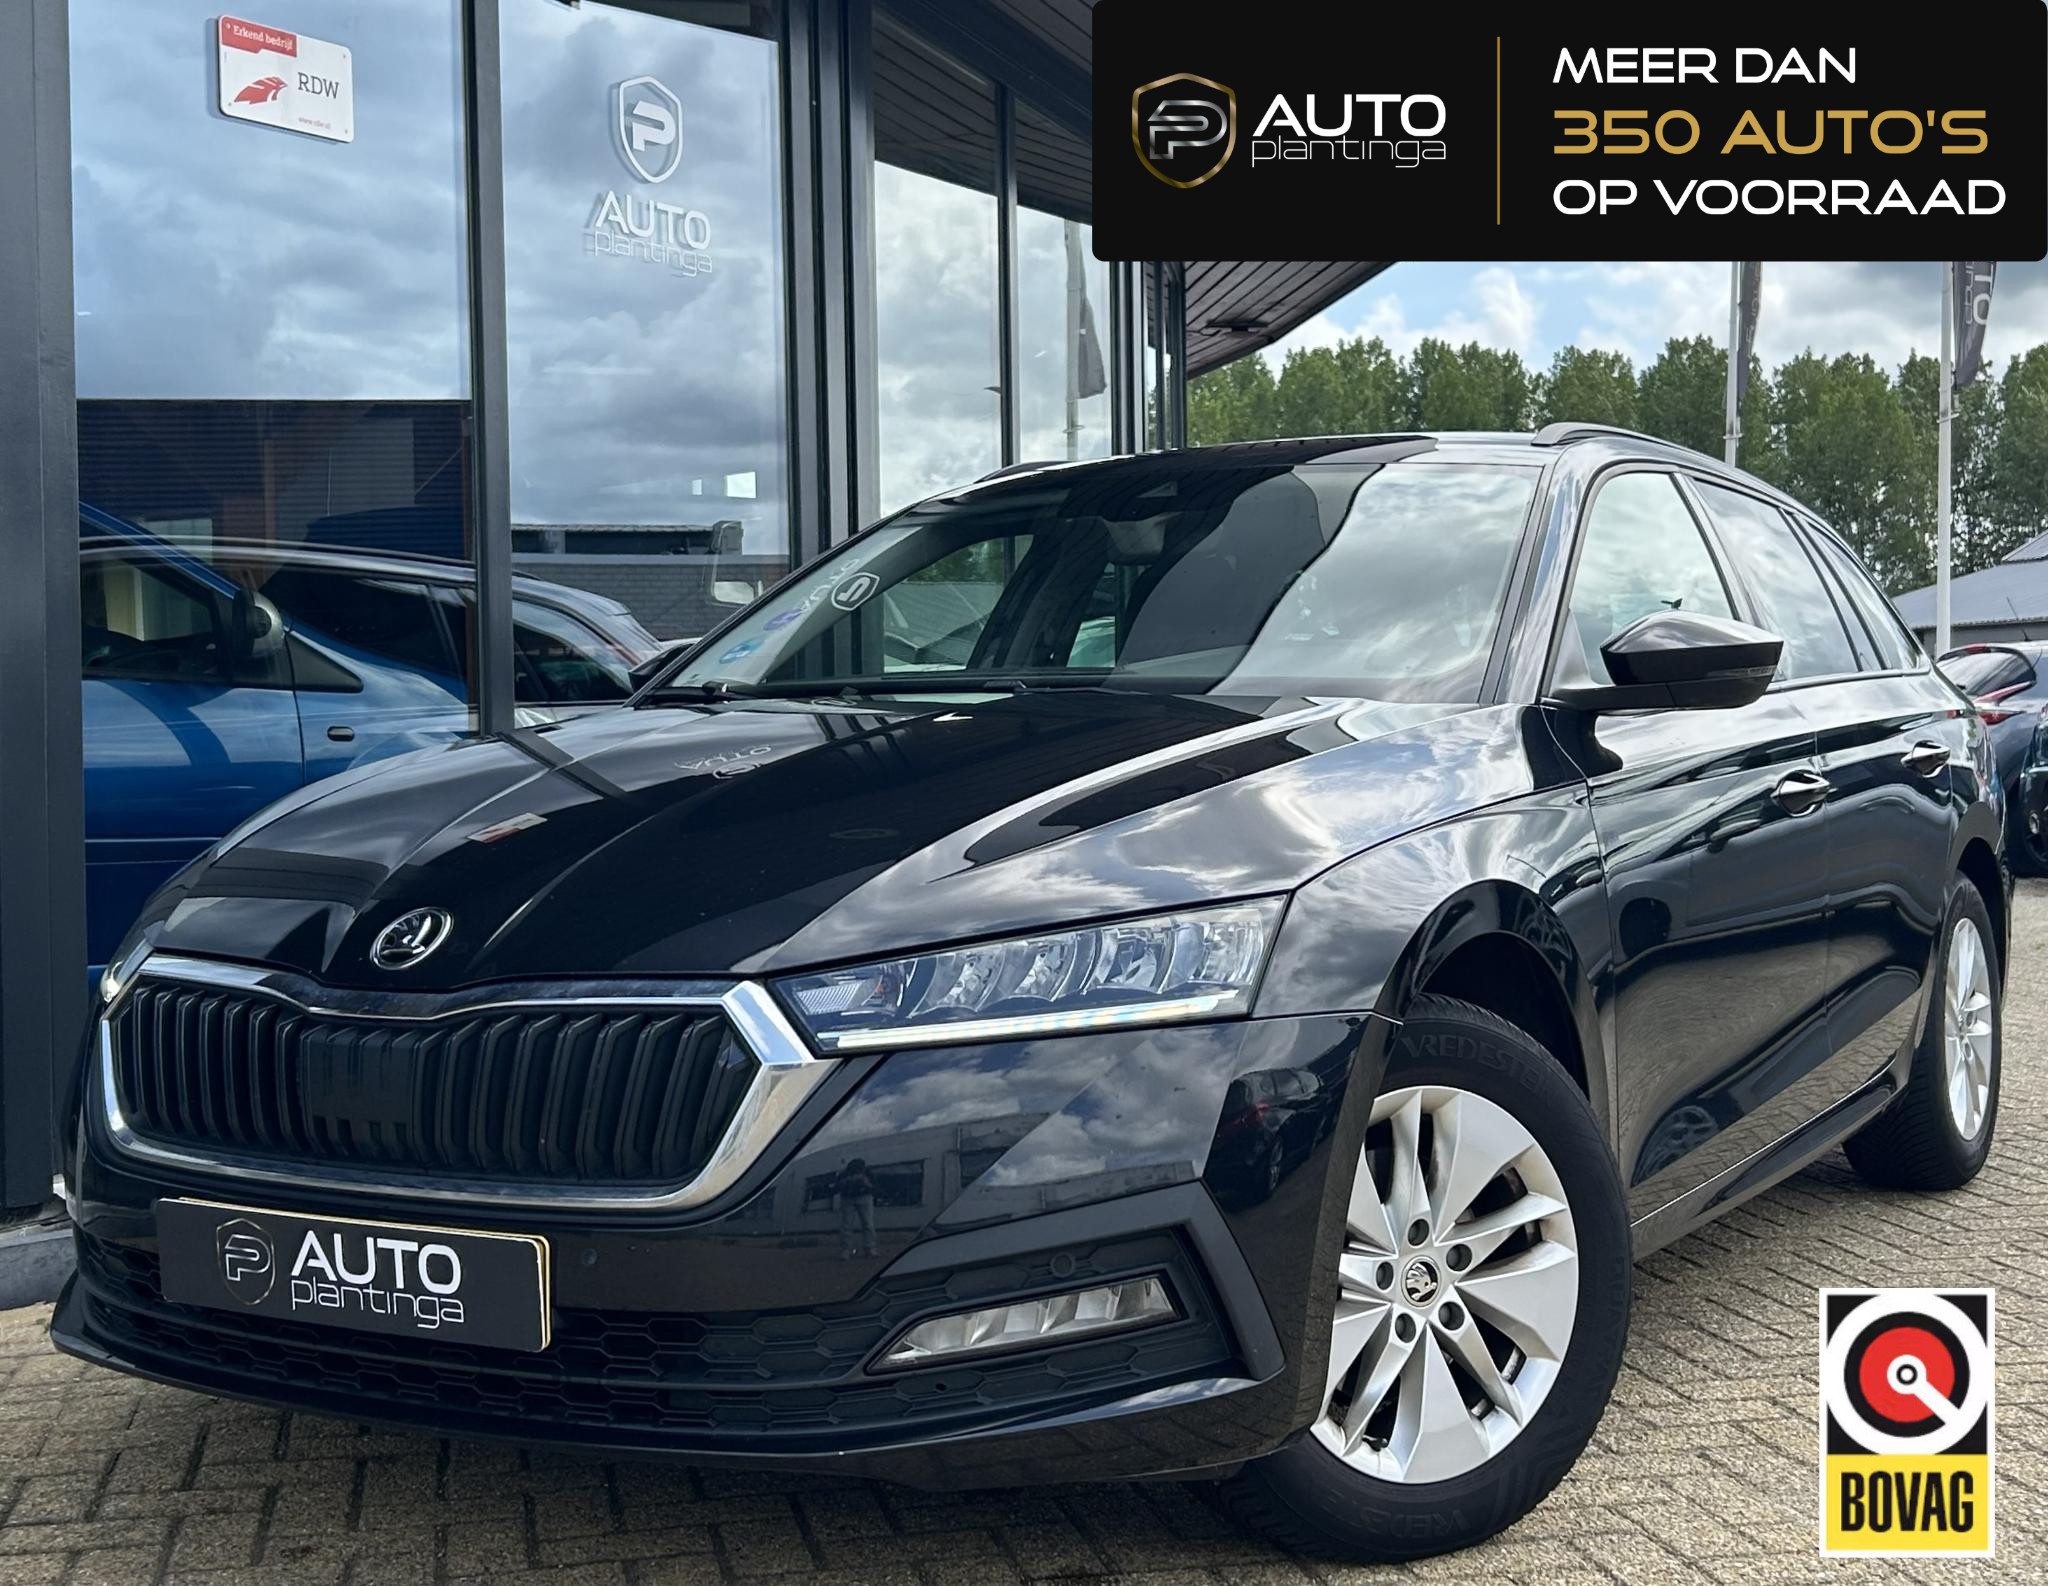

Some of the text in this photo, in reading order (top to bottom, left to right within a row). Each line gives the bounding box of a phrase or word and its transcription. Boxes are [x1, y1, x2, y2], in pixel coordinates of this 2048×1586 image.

[233, 25, 294, 51] Erkend bedrijf
[298, 71, 340, 99] RDW
[595, 190, 712, 250] AUTO
[594, 230, 713, 277] plantinga
[1973, 263, 1994, 326] TO
[1400, 1033, 1550, 1103] VREDESTE
[290, 1229, 462, 1294] AUTO
[291, 1276, 465, 1330] plantinga
